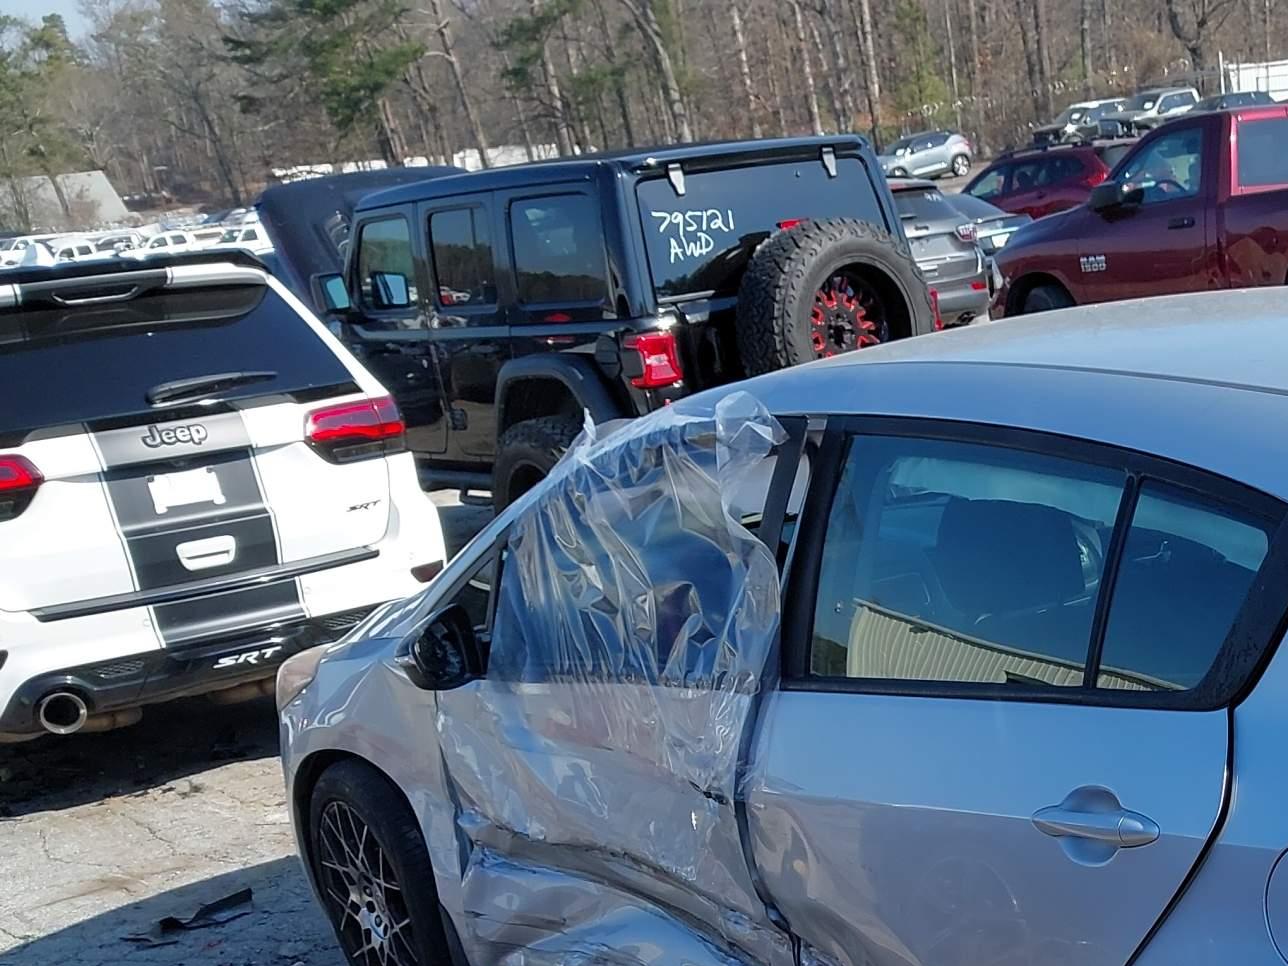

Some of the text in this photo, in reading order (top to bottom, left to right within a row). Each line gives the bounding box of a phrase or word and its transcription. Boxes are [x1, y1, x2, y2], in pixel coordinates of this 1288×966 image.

[669, 231, 714, 264] AWD
[141, 424, 208, 448] Jeep
[346, 499, 381, 512] SRT
[212, 645, 282, 669] SRT
